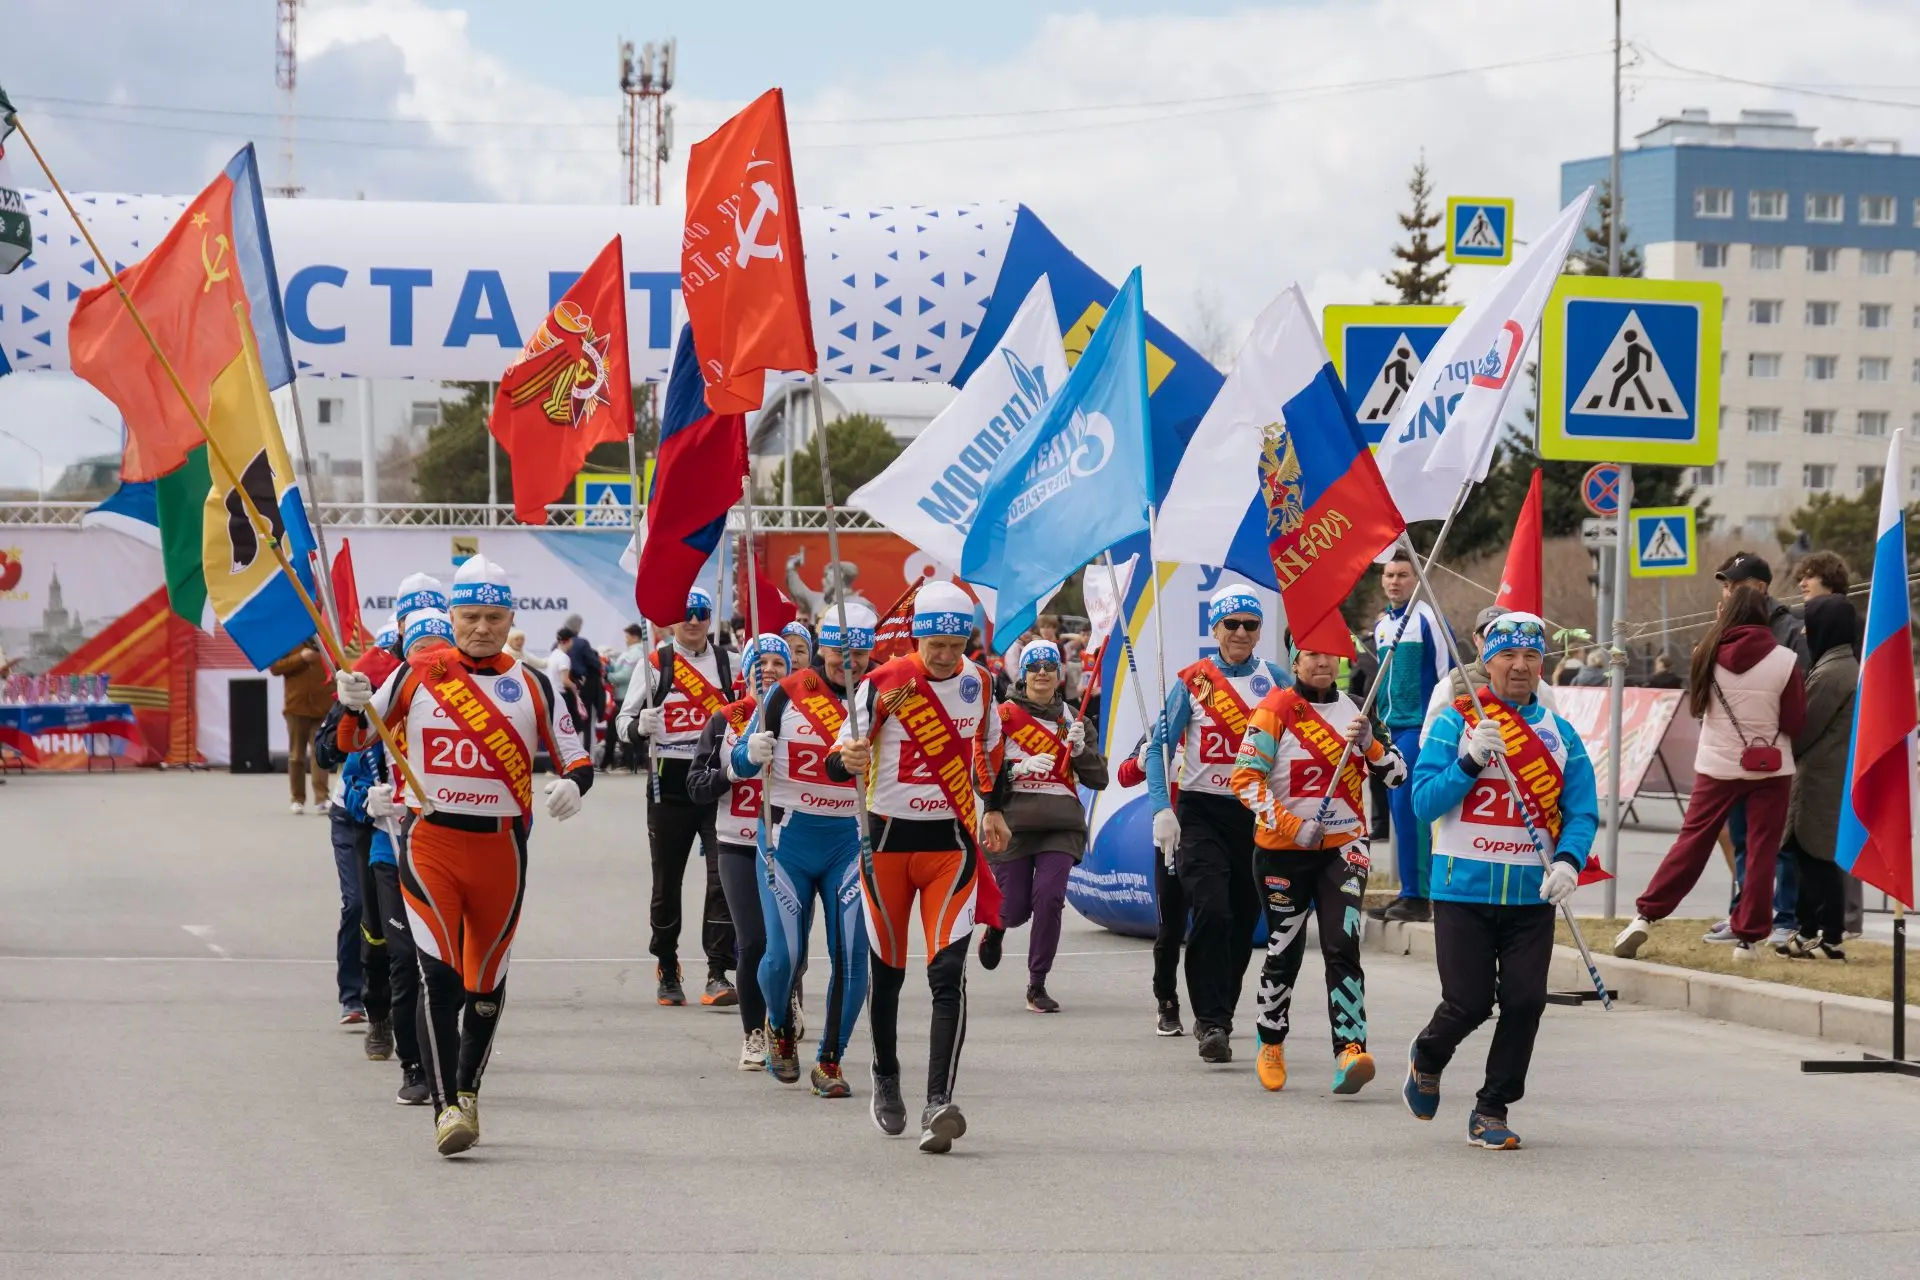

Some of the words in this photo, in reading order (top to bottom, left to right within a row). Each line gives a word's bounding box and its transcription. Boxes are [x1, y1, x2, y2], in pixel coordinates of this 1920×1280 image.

[434, 677, 491, 732] ДЕНЬ
[897, 694, 952, 757] ДЕНЬ
[437, 787, 499, 806] Сургут
[800, 792, 855, 810] Сургут
[1472, 836, 1536, 855] Сургут
